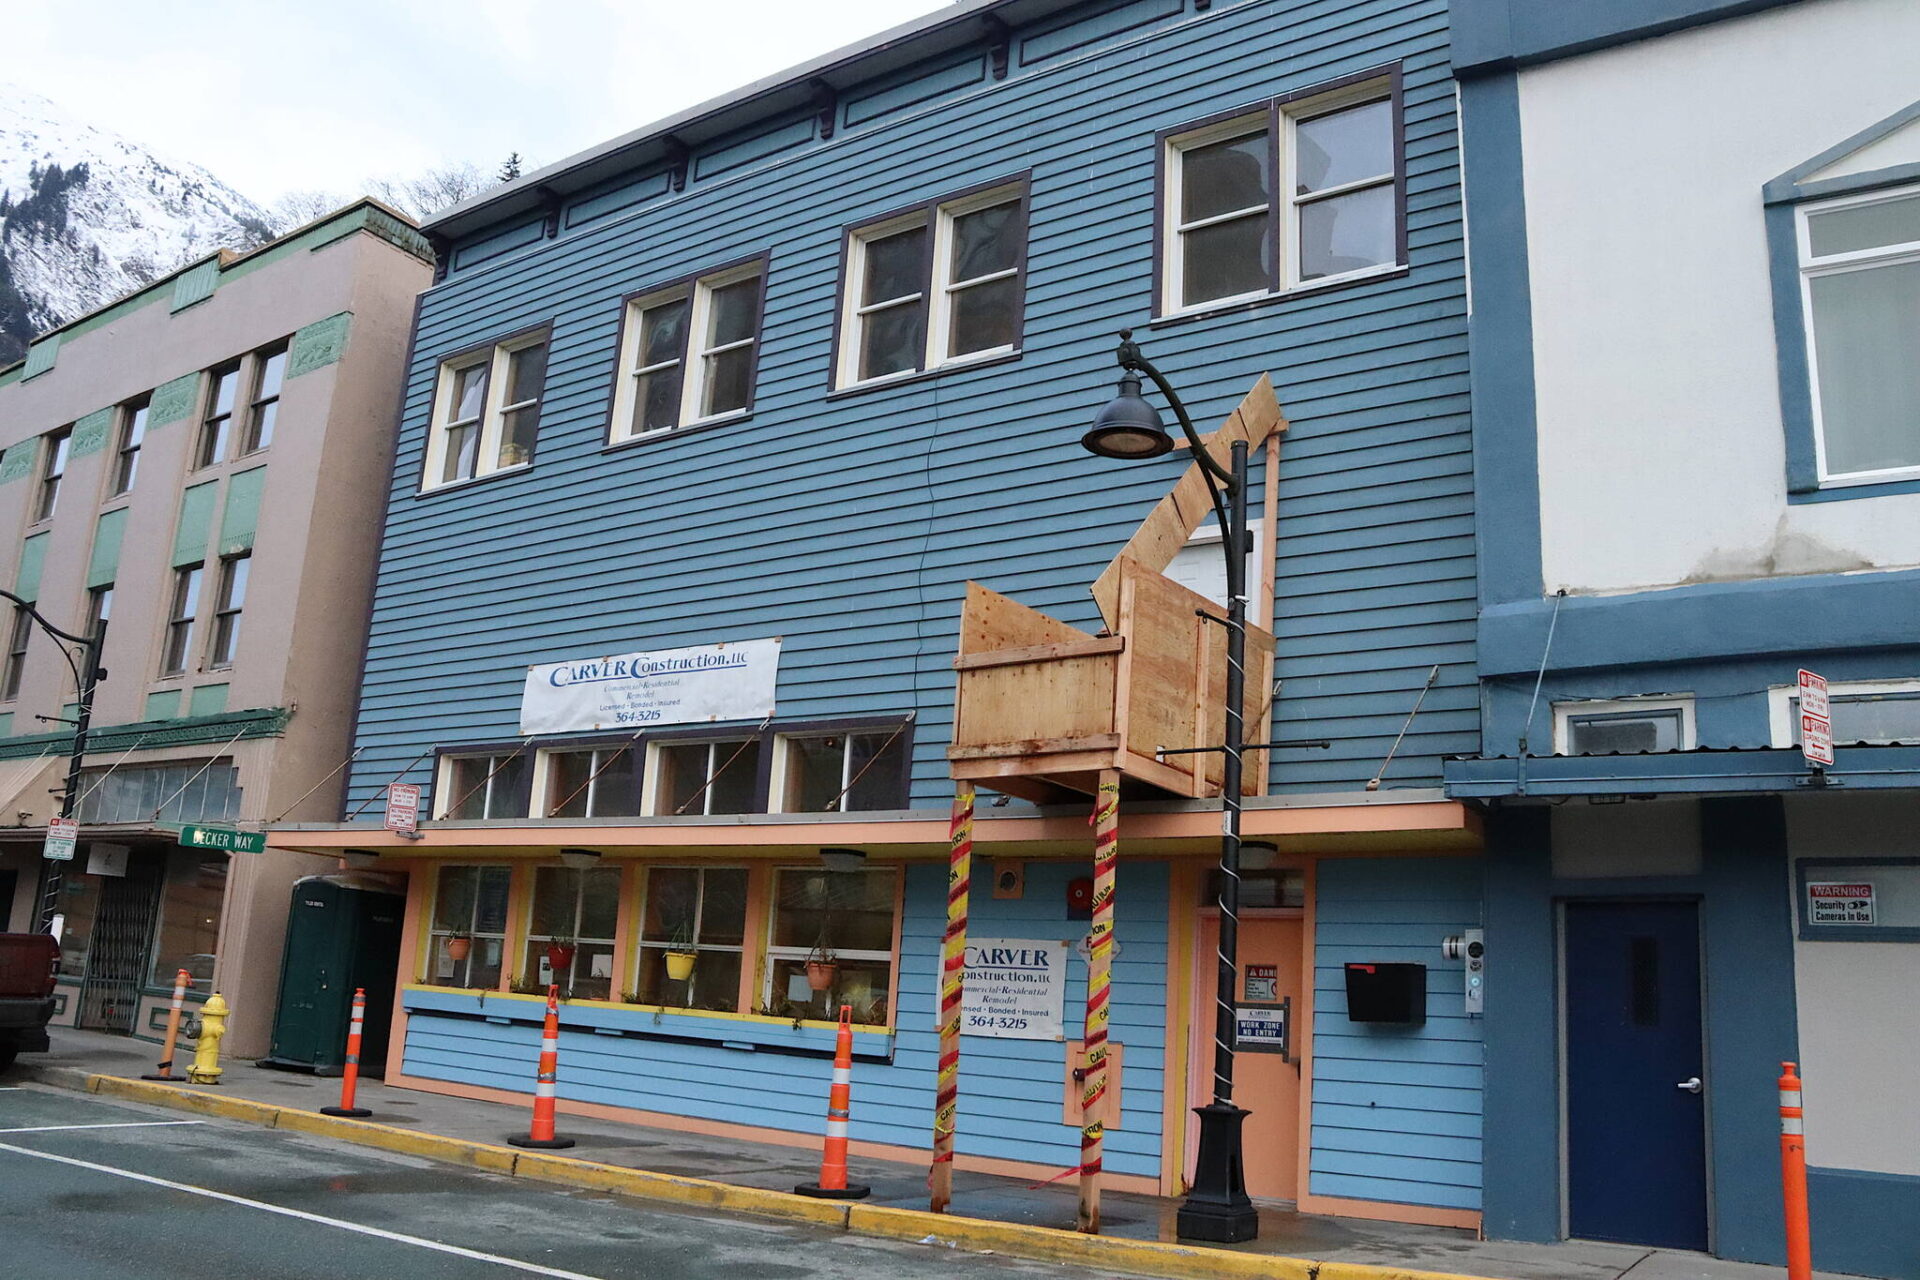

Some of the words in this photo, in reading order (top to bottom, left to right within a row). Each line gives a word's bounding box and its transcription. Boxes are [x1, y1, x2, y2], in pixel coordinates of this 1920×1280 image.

[550, 660, 627, 687] CARVER
[615, 710, 661, 723] 364-3215
[193, 829, 229, 847] DECKER
[234, 834, 253, 850] WAY
[1814, 886, 1869, 897] WARNING
[1815, 900, 1846, 910] Security
[1815, 911, 1846, 921] Cameras
[1848, 911, 1855, 921] In
[1857, 911, 1870, 921] Use
[963, 946, 1049, 969] CARVER
[982, 995, 1017, 1005] Remodel
[988, 1006, 1016, 1015] Bonded
[1022, 1008, 1049, 1017] Insured
[968, 1015, 1027, 1029] 364-3215
[1240, 1021, 1260, 1029] WORK
[1263, 1022, 1280, 1030] ZONE
[1255, 1029, 1277, 1037] ENTRY
